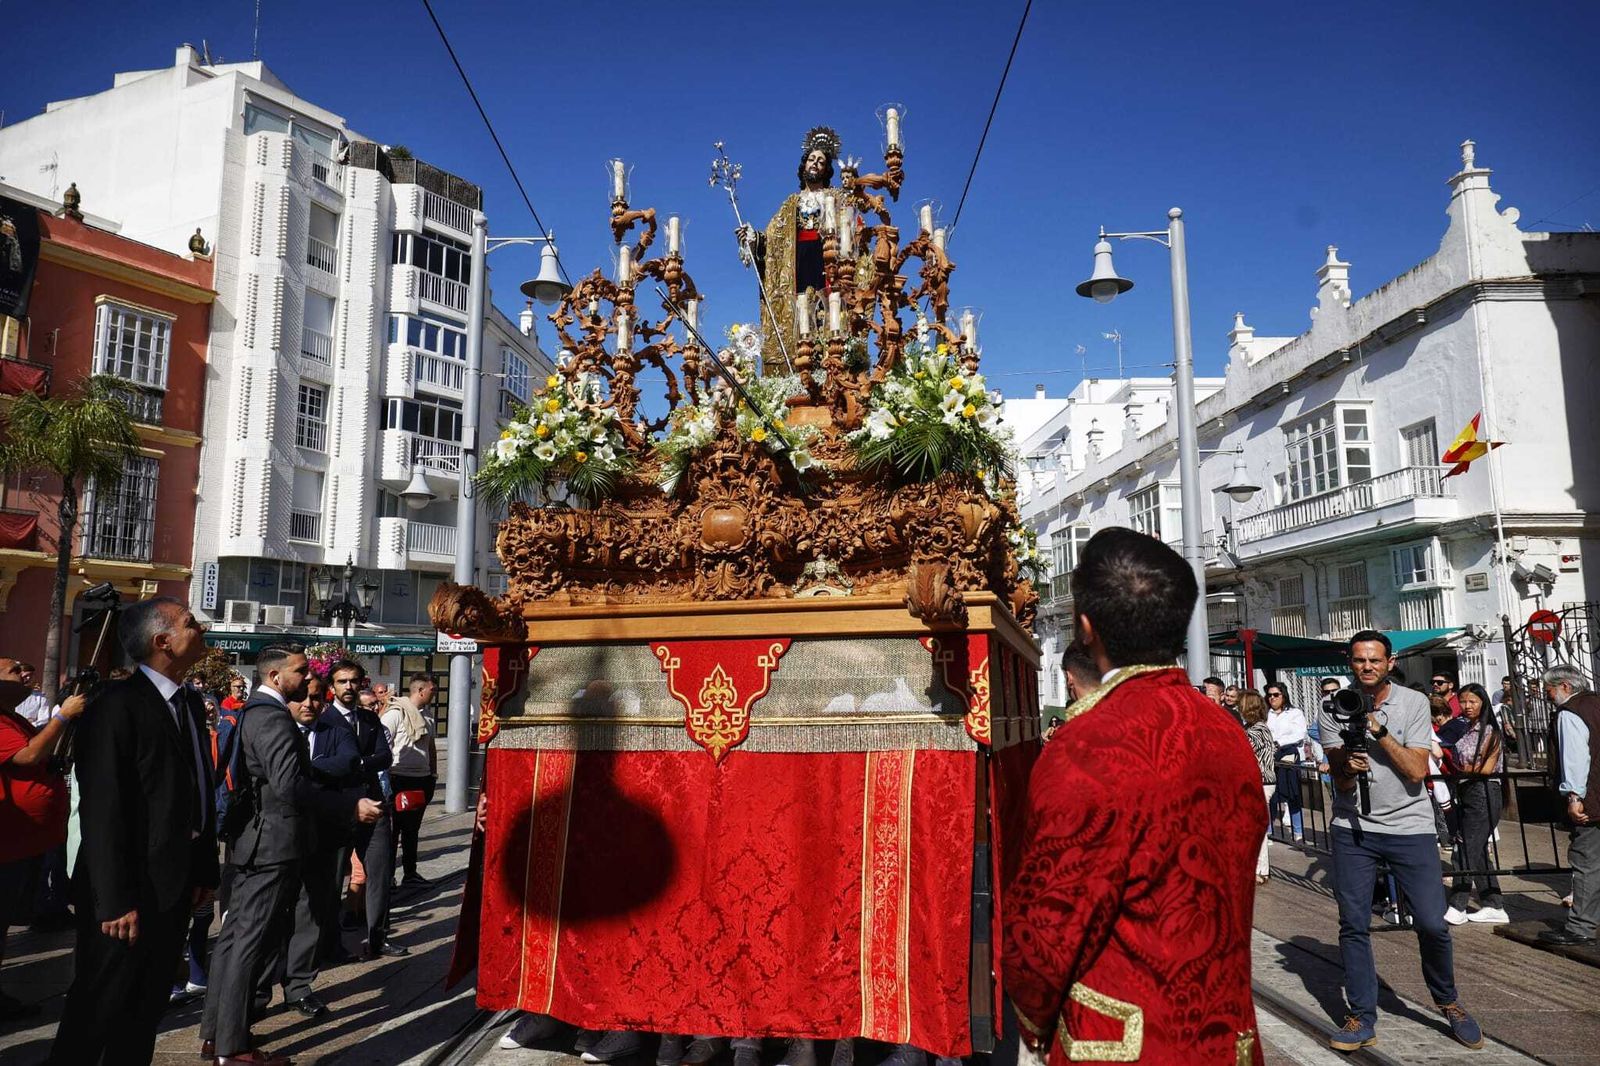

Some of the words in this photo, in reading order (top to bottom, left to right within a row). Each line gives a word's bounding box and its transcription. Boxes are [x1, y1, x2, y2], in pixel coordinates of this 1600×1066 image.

[206, 564, 216, 608] ABOGADOS
[214, 640, 251, 650] DELICCIA
[355, 644, 386, 653] DELICCIA
